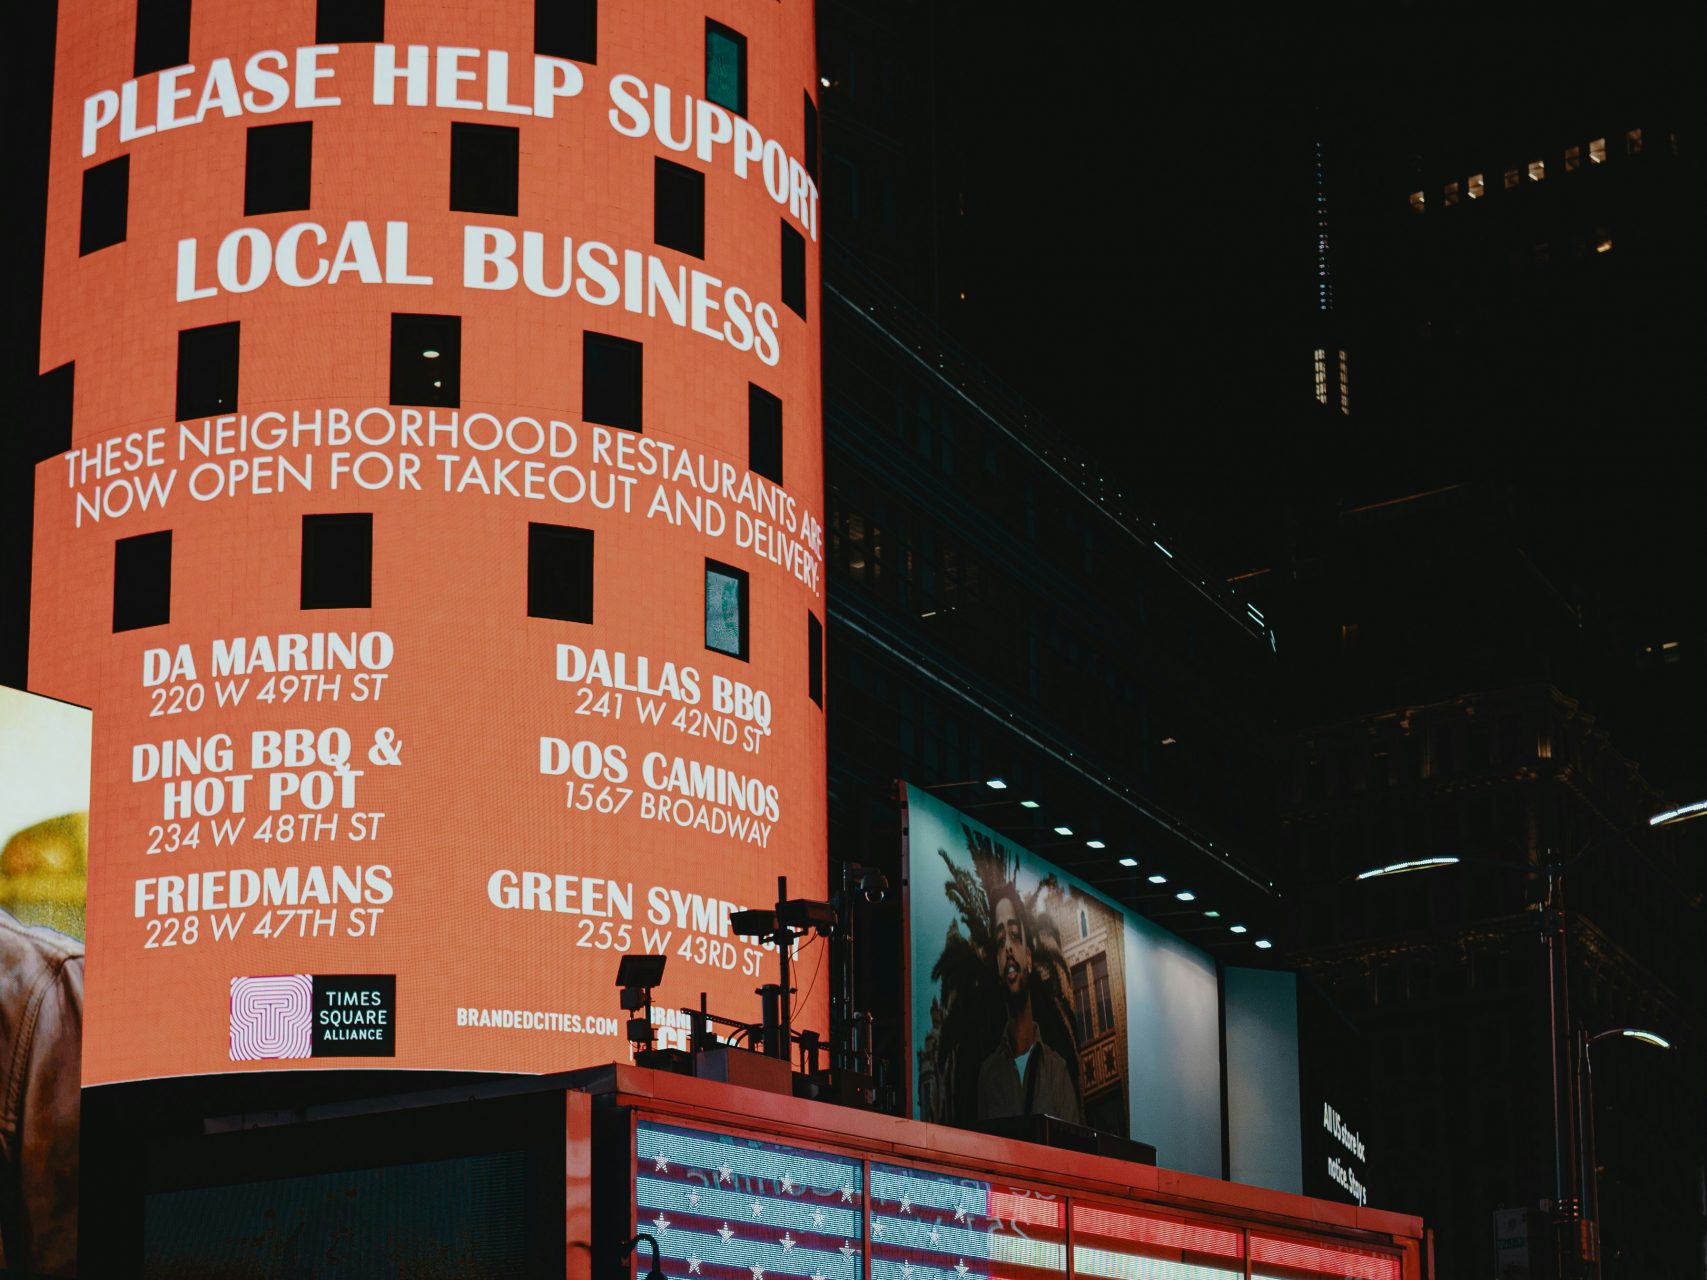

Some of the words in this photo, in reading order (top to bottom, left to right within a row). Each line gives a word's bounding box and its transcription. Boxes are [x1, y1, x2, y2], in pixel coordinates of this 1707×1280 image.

[82, 46, 341, 157] PLEASE
[373, 44, 583, 118] HELP
[609, 74, 817, 240] SUPPORT
[177, 221, 433, 302] LOCAL
[464, 226, 779, 366] BUSINESS
[65, 428, 165, 487] THESE
[180, 407, 577, 460] NEIGHBORHOOD
[593, 428, 796, 532] RESTAURANTS
[801, 512, 821, 560] ARE
[76, 469, 176, 527] NOW
[189, 454, 312, 501] OPEN
[331, 452, 421, 490] FOR
[437, 455, 637, 512] TAKEOUT
[648, 485, 725, 536] AND
[144, 644, 196, 686] DA
[212, 631, 393, 677] MARINO
[150, 683, 204, 716] 220
[215, 679, 249, 707] W
[257, 674, 341, 703] 49TH
[351, 673, 388, 701] ST
[557, 644, 700, 704] DALLAS
[713, 675, 772, 736] BBQ
[576, 688, 622, 719] 241
[637, 697, 666, 725] W
[672, 707, 737, 744] 42ND
[743, 726, 763, 753] ST
[133, 734, 233, 782] DING
[252, 727, 352, 772] BBQ
[368, 727, 402, 765] &
[540, 737, 628, 783] DOS
[643, 752, 779, 822] CAMINOS
[164, 775, 253, 820] HOT
[269, 770, 364, 811] POT
[567, 781, 633, 813] 1567
[641, 792, 771, 848] BROADWAY
[147, 822, 199, 854] 234
[211, 818, 245, 846] W
[254, 814, 338, 842] 48TH
[349, 812, 385, 841] ST
[135, 865, 393, 917] FRIEDMANS
[488, 870, 632, 920] GREEN
[145, 916, 199, 948] 228
[211, 912, 245, 941] W
[253, 909, 336, 938] 47TH
[347, 908, 384, 936] ST
[576, 920, 632, 952] 255
[642, 927, 671, 955] W
[677, 935, 736, 969] 43RD
[743, 948, 763, 976] ST
[319, 1010, 388, 1027] SQUARE
[326, 991, 381, 1007] TIMES
[456, 1007, 618, 1037] BRANDEDCITIES.COM
[324, 1029, 384, 1041] ALLIANCE
[1323, 1101, 1333, 1134] All
[1332, 1109, 1341, 1141] US
[1341, 1123, 1357, 1156] store
[1348, 1167, 1363, 1207] Stay
